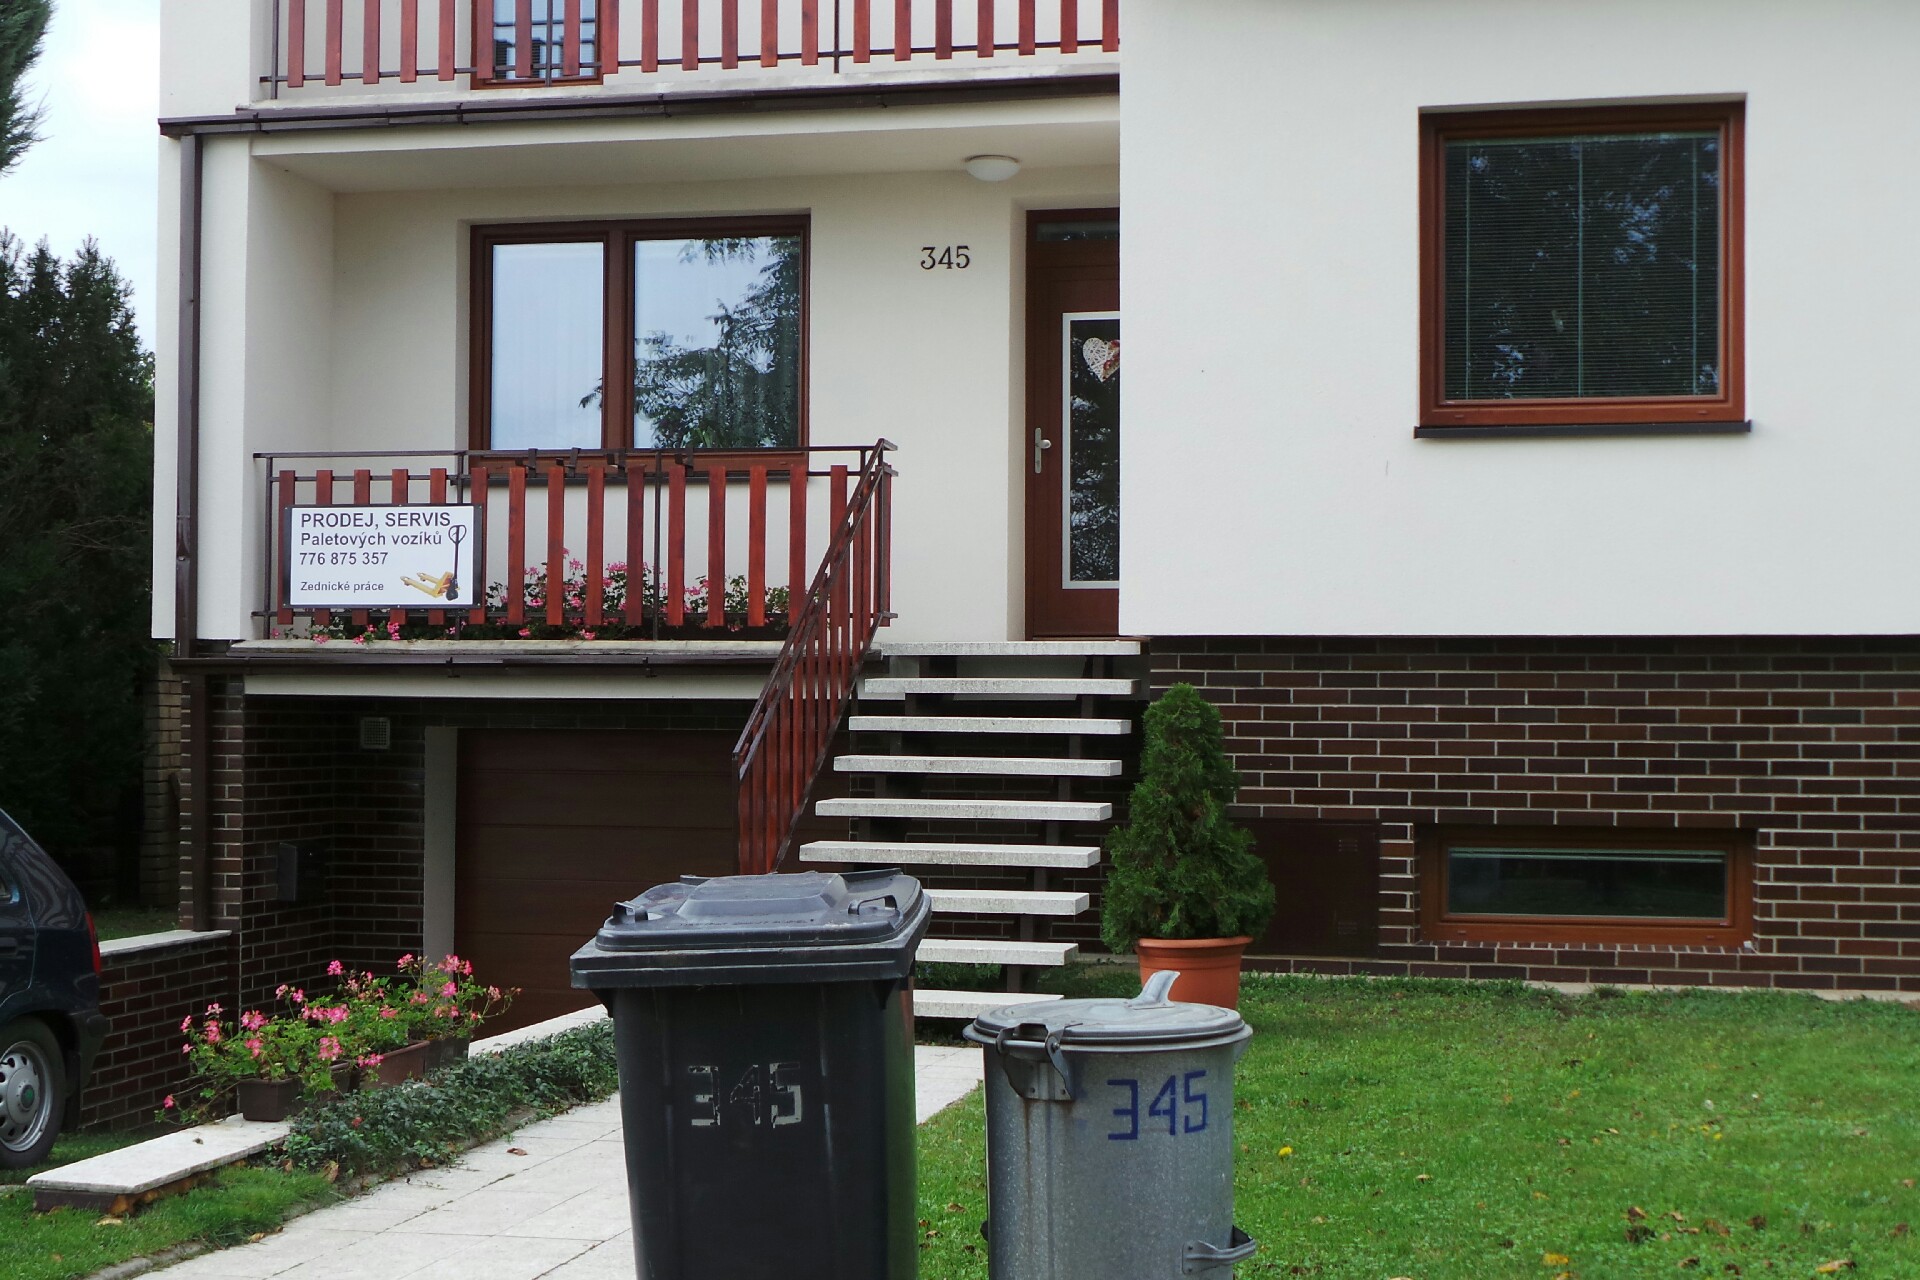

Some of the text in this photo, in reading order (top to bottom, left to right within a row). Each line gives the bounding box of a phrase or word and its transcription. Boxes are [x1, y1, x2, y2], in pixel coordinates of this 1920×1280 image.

[920, 245, 970, 270] 345
[301, 512, 450, 530] PRODEJ, SERVIS
[301, 531, 442, 548] Paletových vozíků
[300, 552, 388, 565] 776 875 357
[300, 581, 384, 593] Zednické práce
[688, 1062, 802, 1128] 345
[1107, 1069, 1208, 1140] 345
